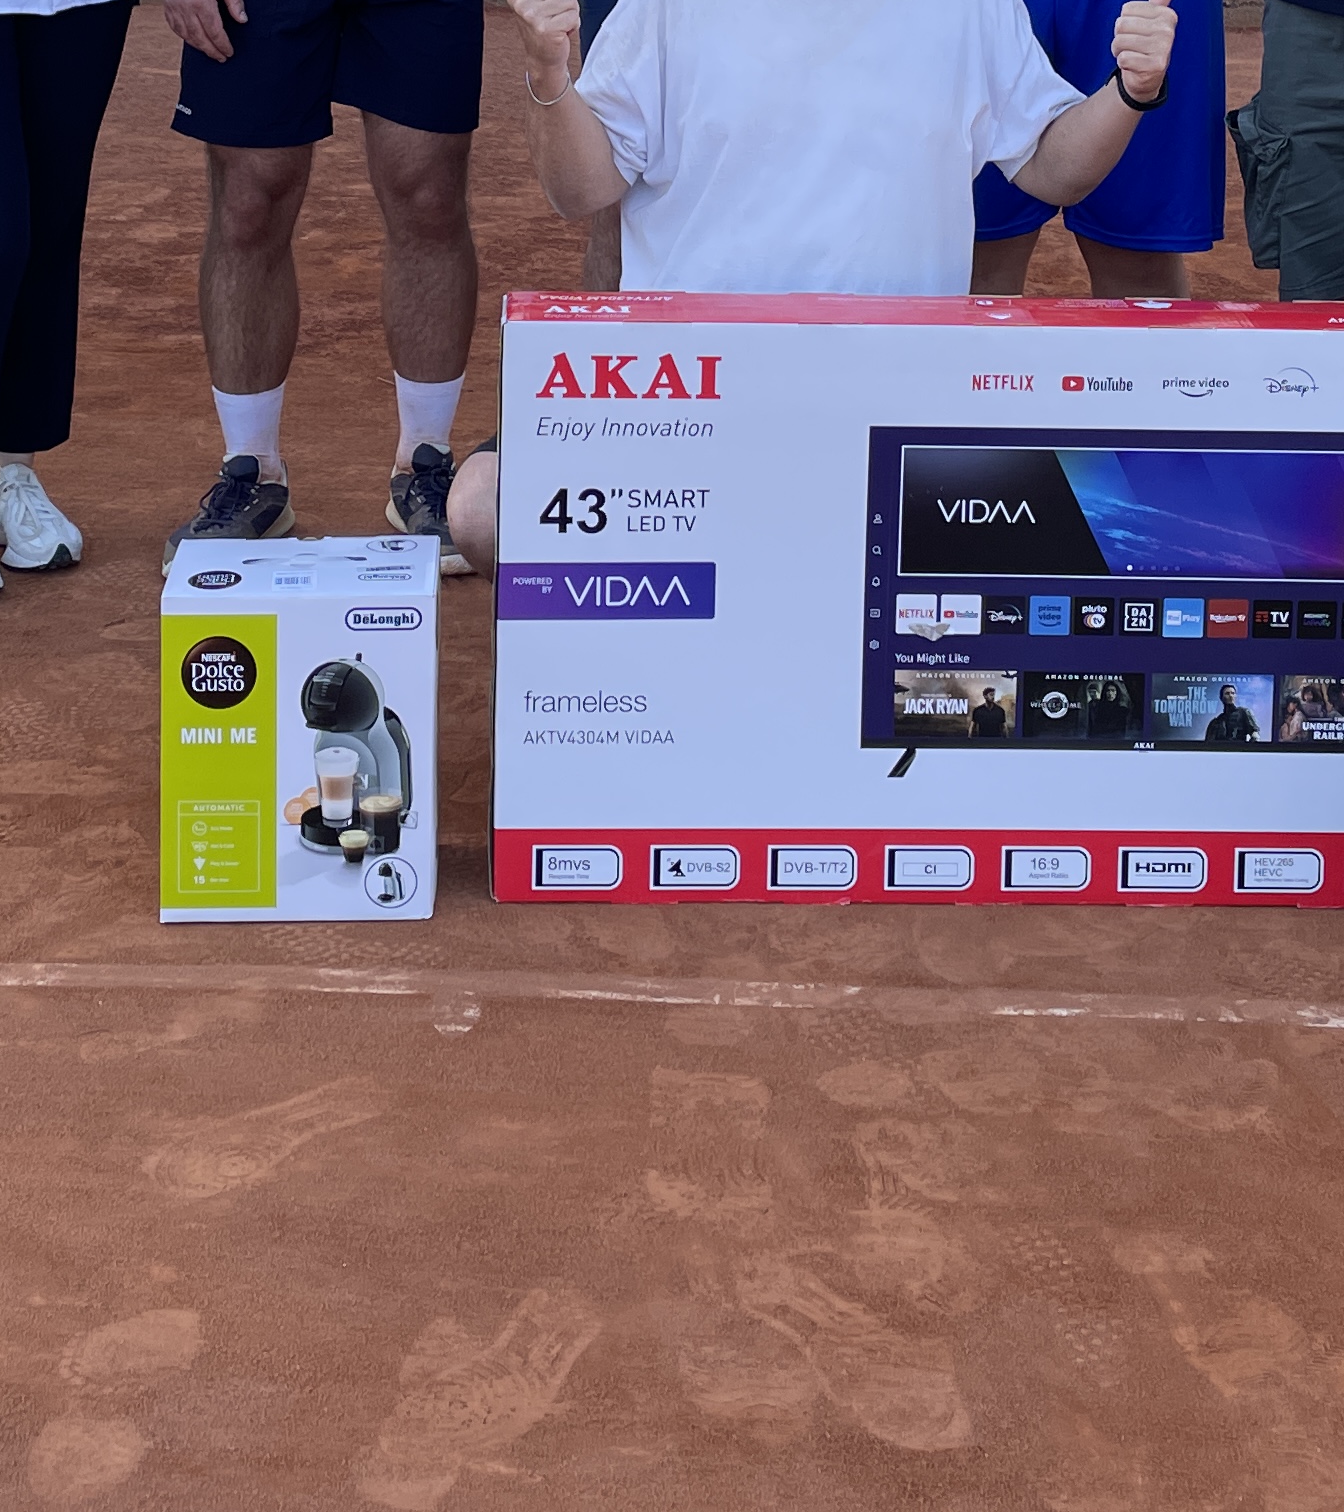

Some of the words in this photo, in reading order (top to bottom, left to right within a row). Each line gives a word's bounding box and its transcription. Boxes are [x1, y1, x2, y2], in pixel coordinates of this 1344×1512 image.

[543, 305, 631, 313] AKAI
[536, 352, 722, 400] AKAI
[972, 374, 1034, 392] NETFLIX
[1162, 378, 1197, 389] prime
[1199, 377, 1230, 388] video
[1087, 377, 1133, 392] YouTube
[537, 417, 596, 441] Enjoy
[601, 417, 714, 438] Innovation
[627, 489, 710, 508] SMART
[937, 499, 1036, 524] VIDAA
[627, 515, 666, 532] LED
[672, 515, 697, 532] TV
[512, 577, 553, 586] POWERED
[541, 586, 553, 594] BY
[564, 575, 691, 607] VIDAA
[898, 608, 934, 619] NETFLIX
[1082, 605, 1107, 614] pluto
[1270, 611, 1289, 623] TV
[895, 653, 914, 664] You
[916, 653, 946, 665] Might
[949, 653, 971, 664] Like
[190, 662, 245, 679] Dolce
[916, 672, 951, 680] AMAZON
[191, 677, 245, 692] Gusto
[1187, 686, 1207, 700] THE
[524, 690, 647, 713] frameless
[904, 698, 934, 715] JACK
[936, 698, 968, 715] RYAN
[1154, 699, 1218, 714] TOMORROW
[1168, 713, 1193, 727] WAR
[181, 728, 222, 744] MINI
[230, 728, 257, 744] ME
[523, 730, 619, 744] AKTV4304M
[624, 730, 675, 744] VIDAA
[193, 804, 245, 812] AUTOMATIC
[548, 856, 591, 871] 8mvs
[687, 862, 730, 873] DVB-S2
[784, 862, 848, 874] DVB-T/T2
[1030, 857, 1060, 871] 16:9
[1135, 862, 1191, 873] HDMI
[1028, 872, 1050, 880] Aspect
[1254, 868, 1283, 877] HEVC
